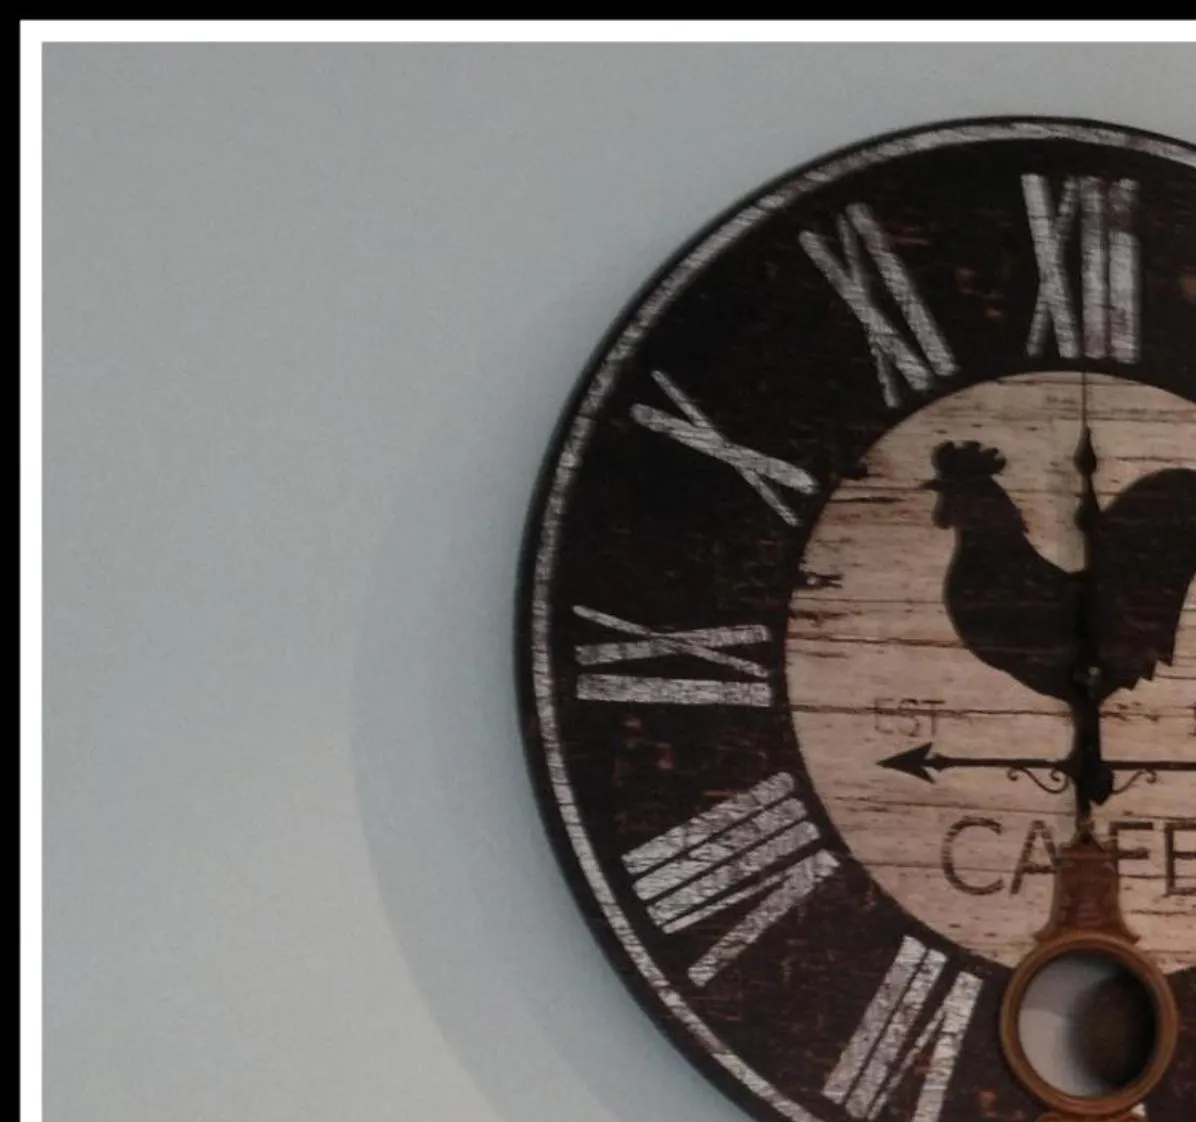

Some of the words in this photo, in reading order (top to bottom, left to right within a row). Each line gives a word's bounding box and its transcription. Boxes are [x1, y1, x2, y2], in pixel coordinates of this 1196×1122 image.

[800, 203, 959, 409] XI
[1021, 174, 1139, 364] XII
[630, 370, 819, 526] X
[572, 605, 773, 707] IX
[874, 697, 946, 738] EST
[621, 771, 841, 987] VIII
